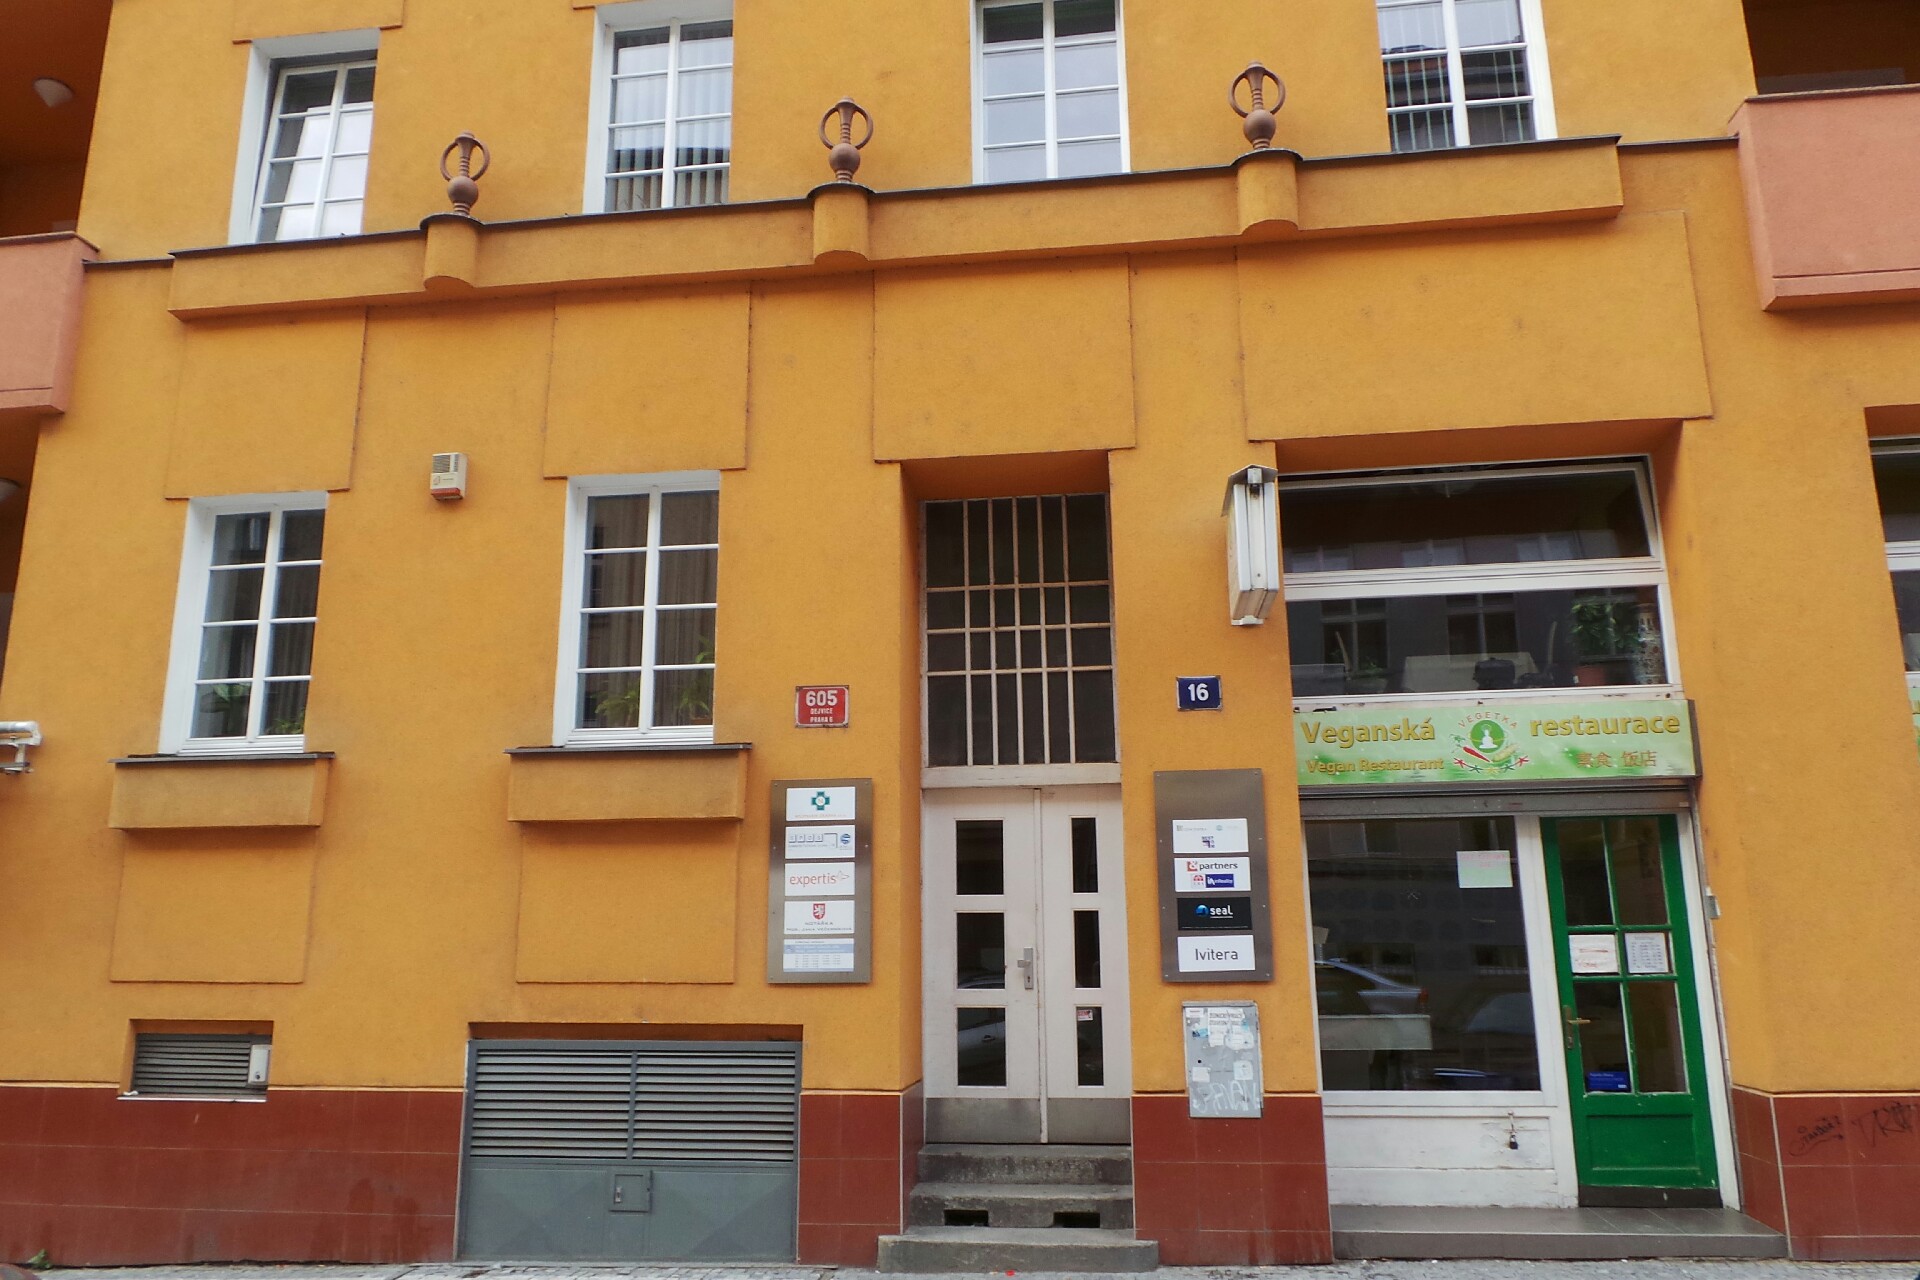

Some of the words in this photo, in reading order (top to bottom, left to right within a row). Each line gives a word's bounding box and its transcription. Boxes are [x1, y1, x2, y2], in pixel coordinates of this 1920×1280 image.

[806, 690, 838, 706] 605
[1188, 683, 1209, 701] 16
[1300, 717, 1436, 748] Veganská
[1530, 715, 1681, 736] restaurace
[1306, 760, 1356, 775] Vegan
[1359, 758, 1445, 772] Restaurant
[1199, 863, 1238, 871] partners
[789, 873, 837, 887] expertis
[1210, 905, 1234, 915] seal
[1195, 948, 1239, 961] Ivitera
